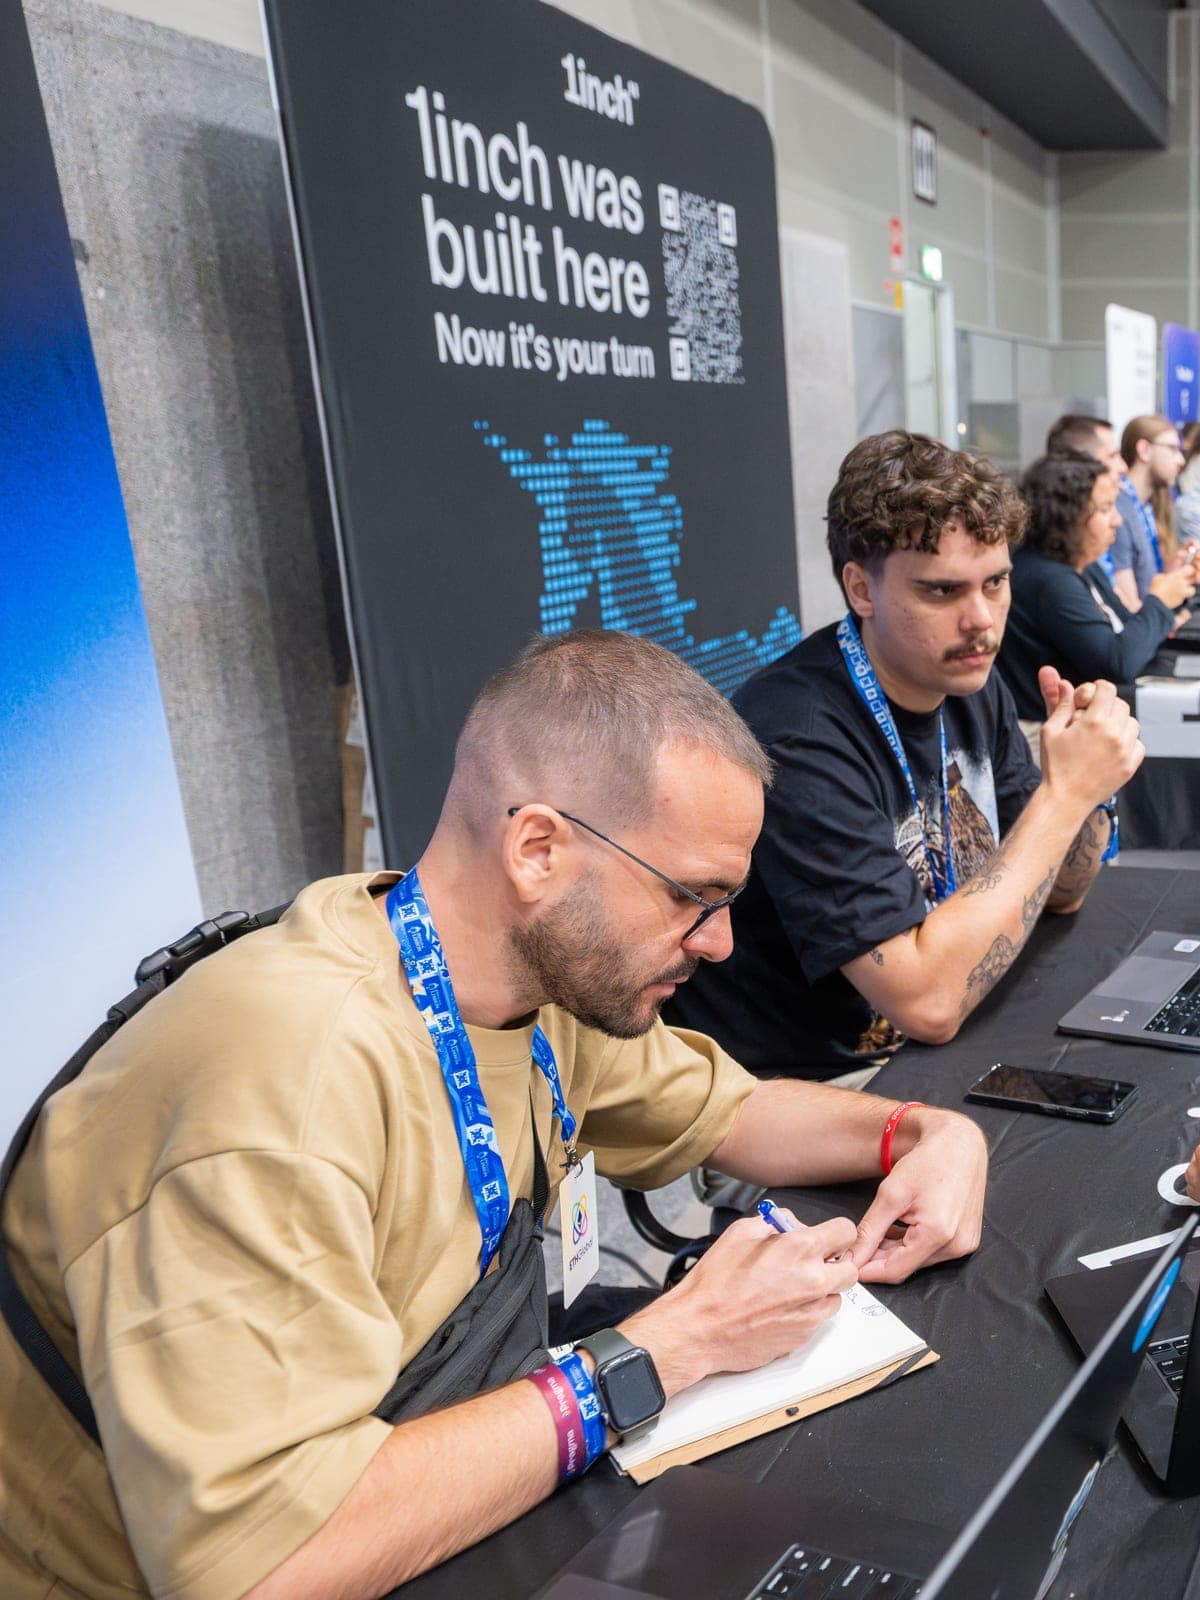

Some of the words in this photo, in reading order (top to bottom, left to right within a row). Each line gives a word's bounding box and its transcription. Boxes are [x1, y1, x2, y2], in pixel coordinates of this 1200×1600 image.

[405, 85, 553, 211] 1inch
[558, 154, 645, 235] was
[421, 193, 548, 303] built
[552, 225, 651, 319] here
[434, 311, 506, 368] Now
[508, 320, 552, 373] it's
[552, 336, 609, 382] your
[609, 336, 656, 379] turn
[569, 1237, 594, 1271] ETHGlobal
[546, 1376, 570, 1412] Pragma
[566, 1429, 578, 1470] Pragma
